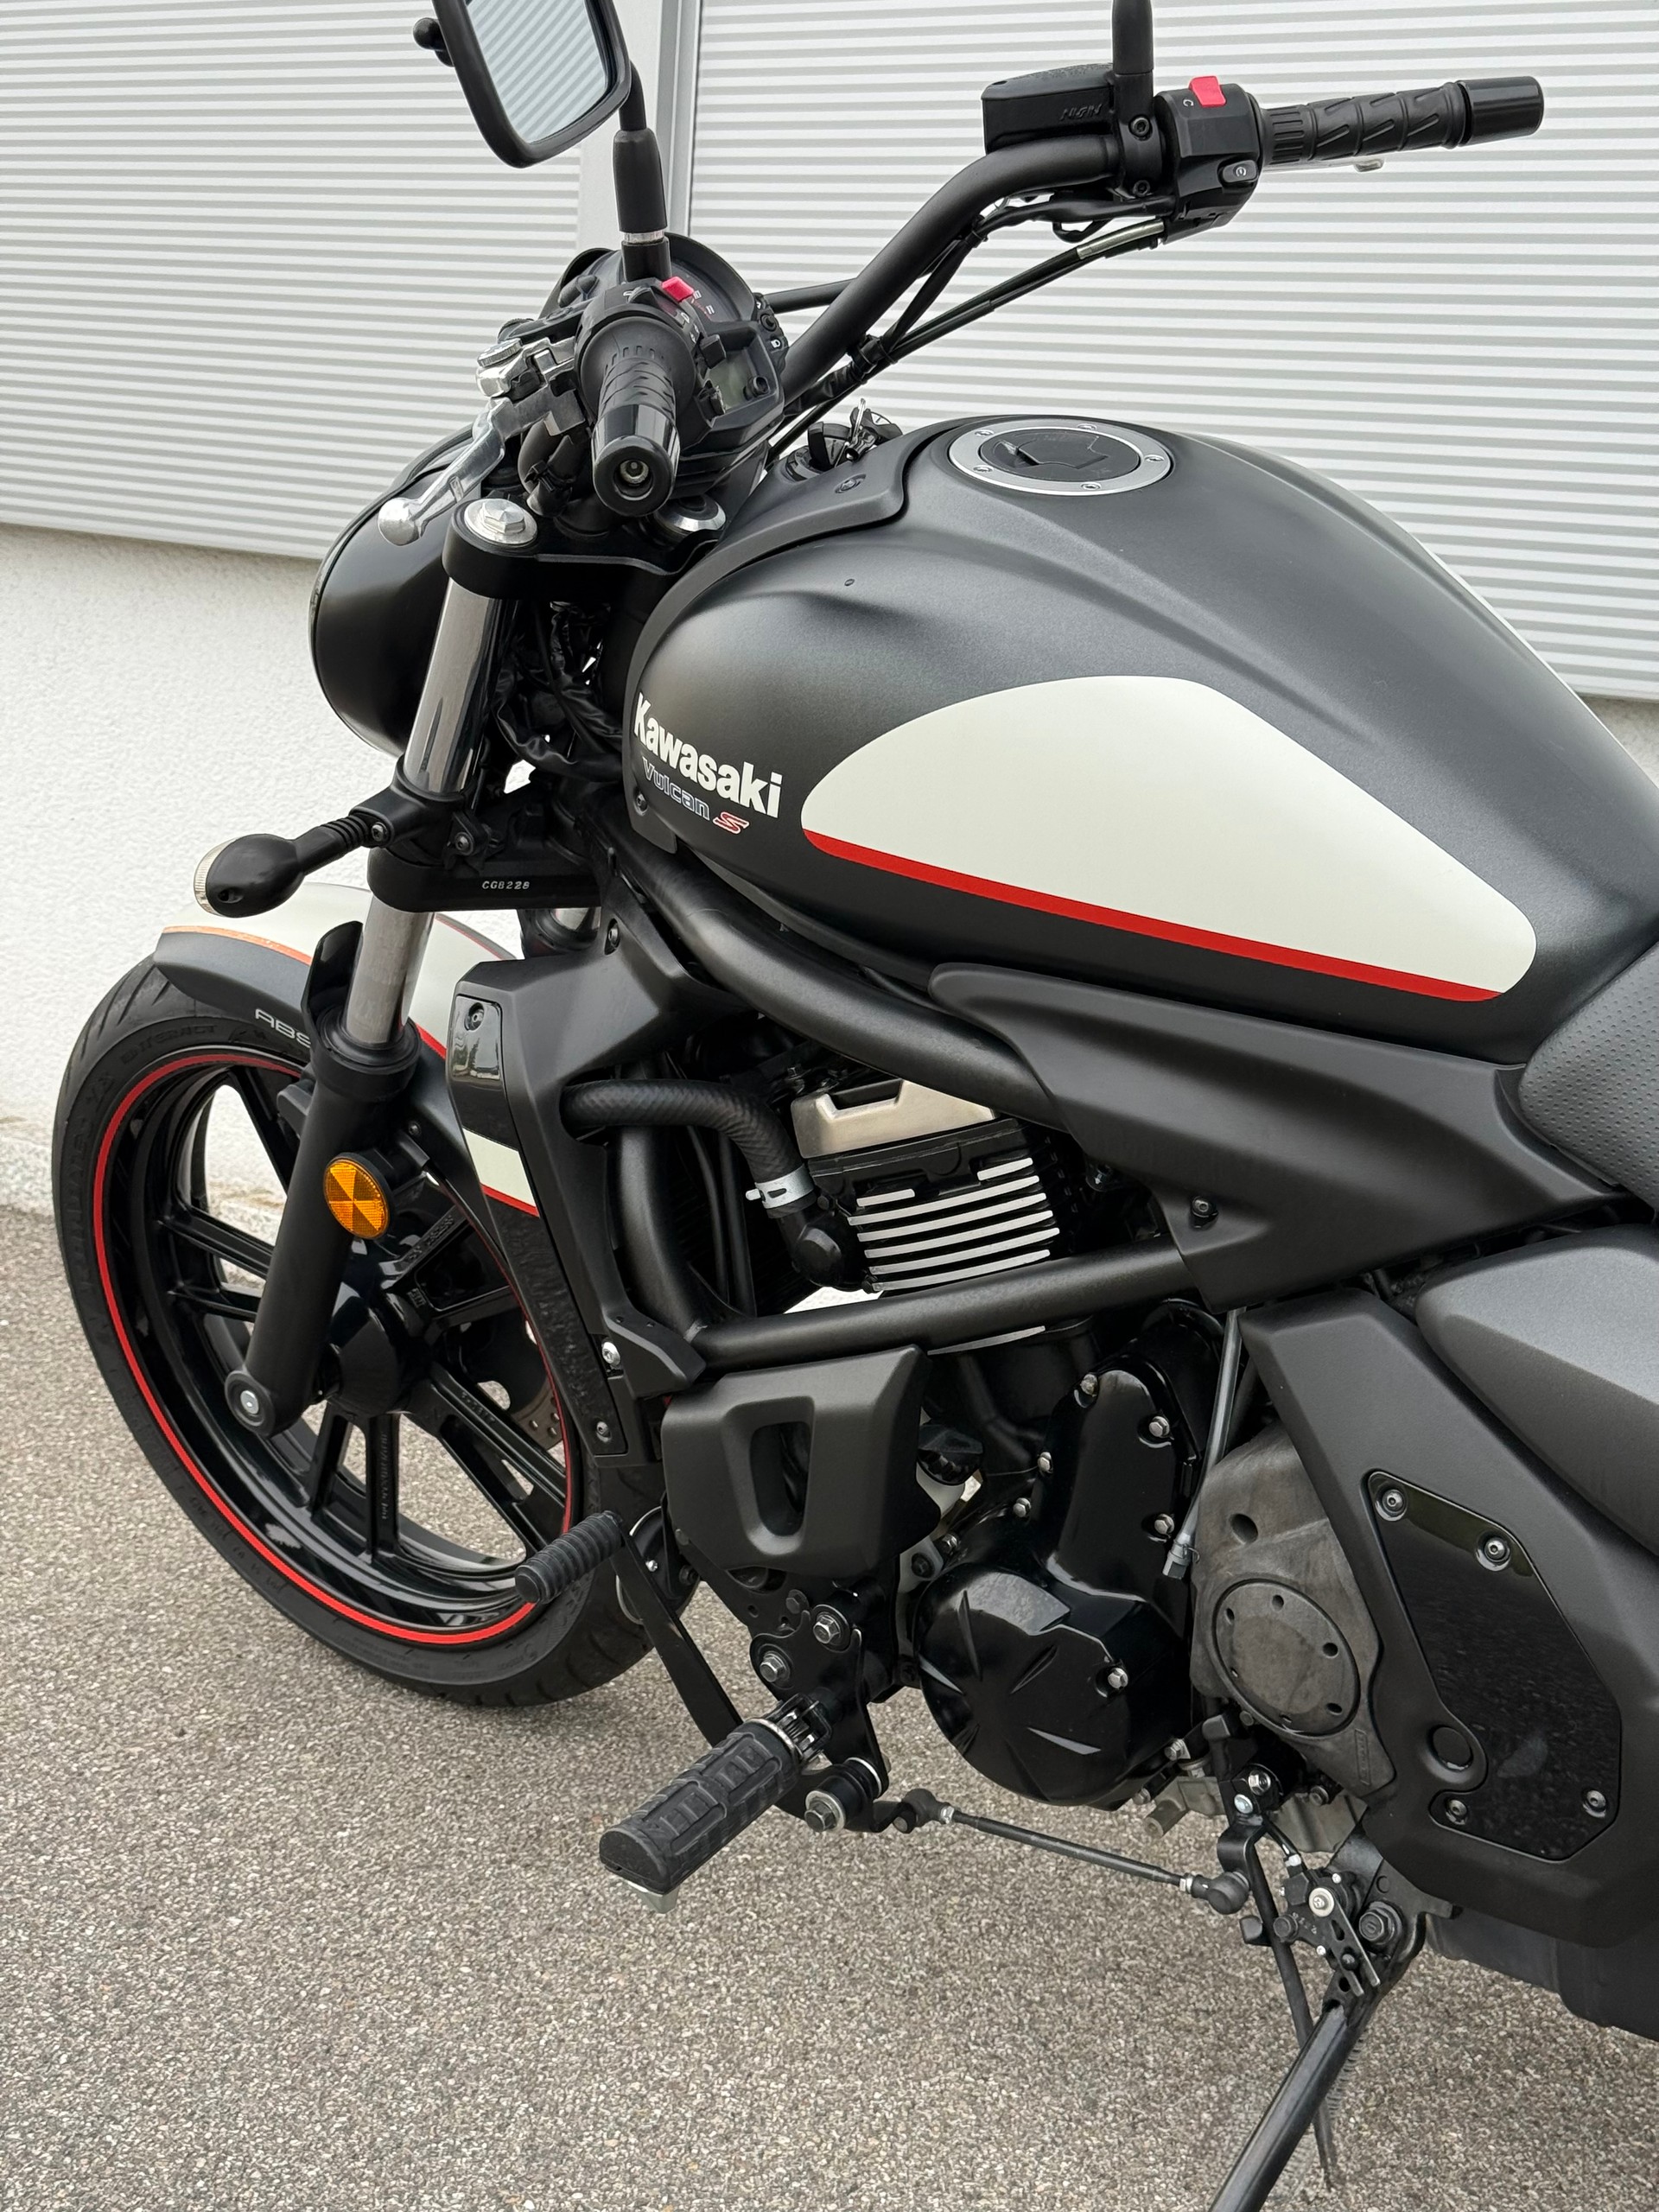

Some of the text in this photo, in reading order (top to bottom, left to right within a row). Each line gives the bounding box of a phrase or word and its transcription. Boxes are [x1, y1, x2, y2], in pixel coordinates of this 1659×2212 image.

[633, 692, 783, 818] Kawasaki
[642, 755, 750, 835] Vulcan S
[255, 1008, 311, 1049] ABS
